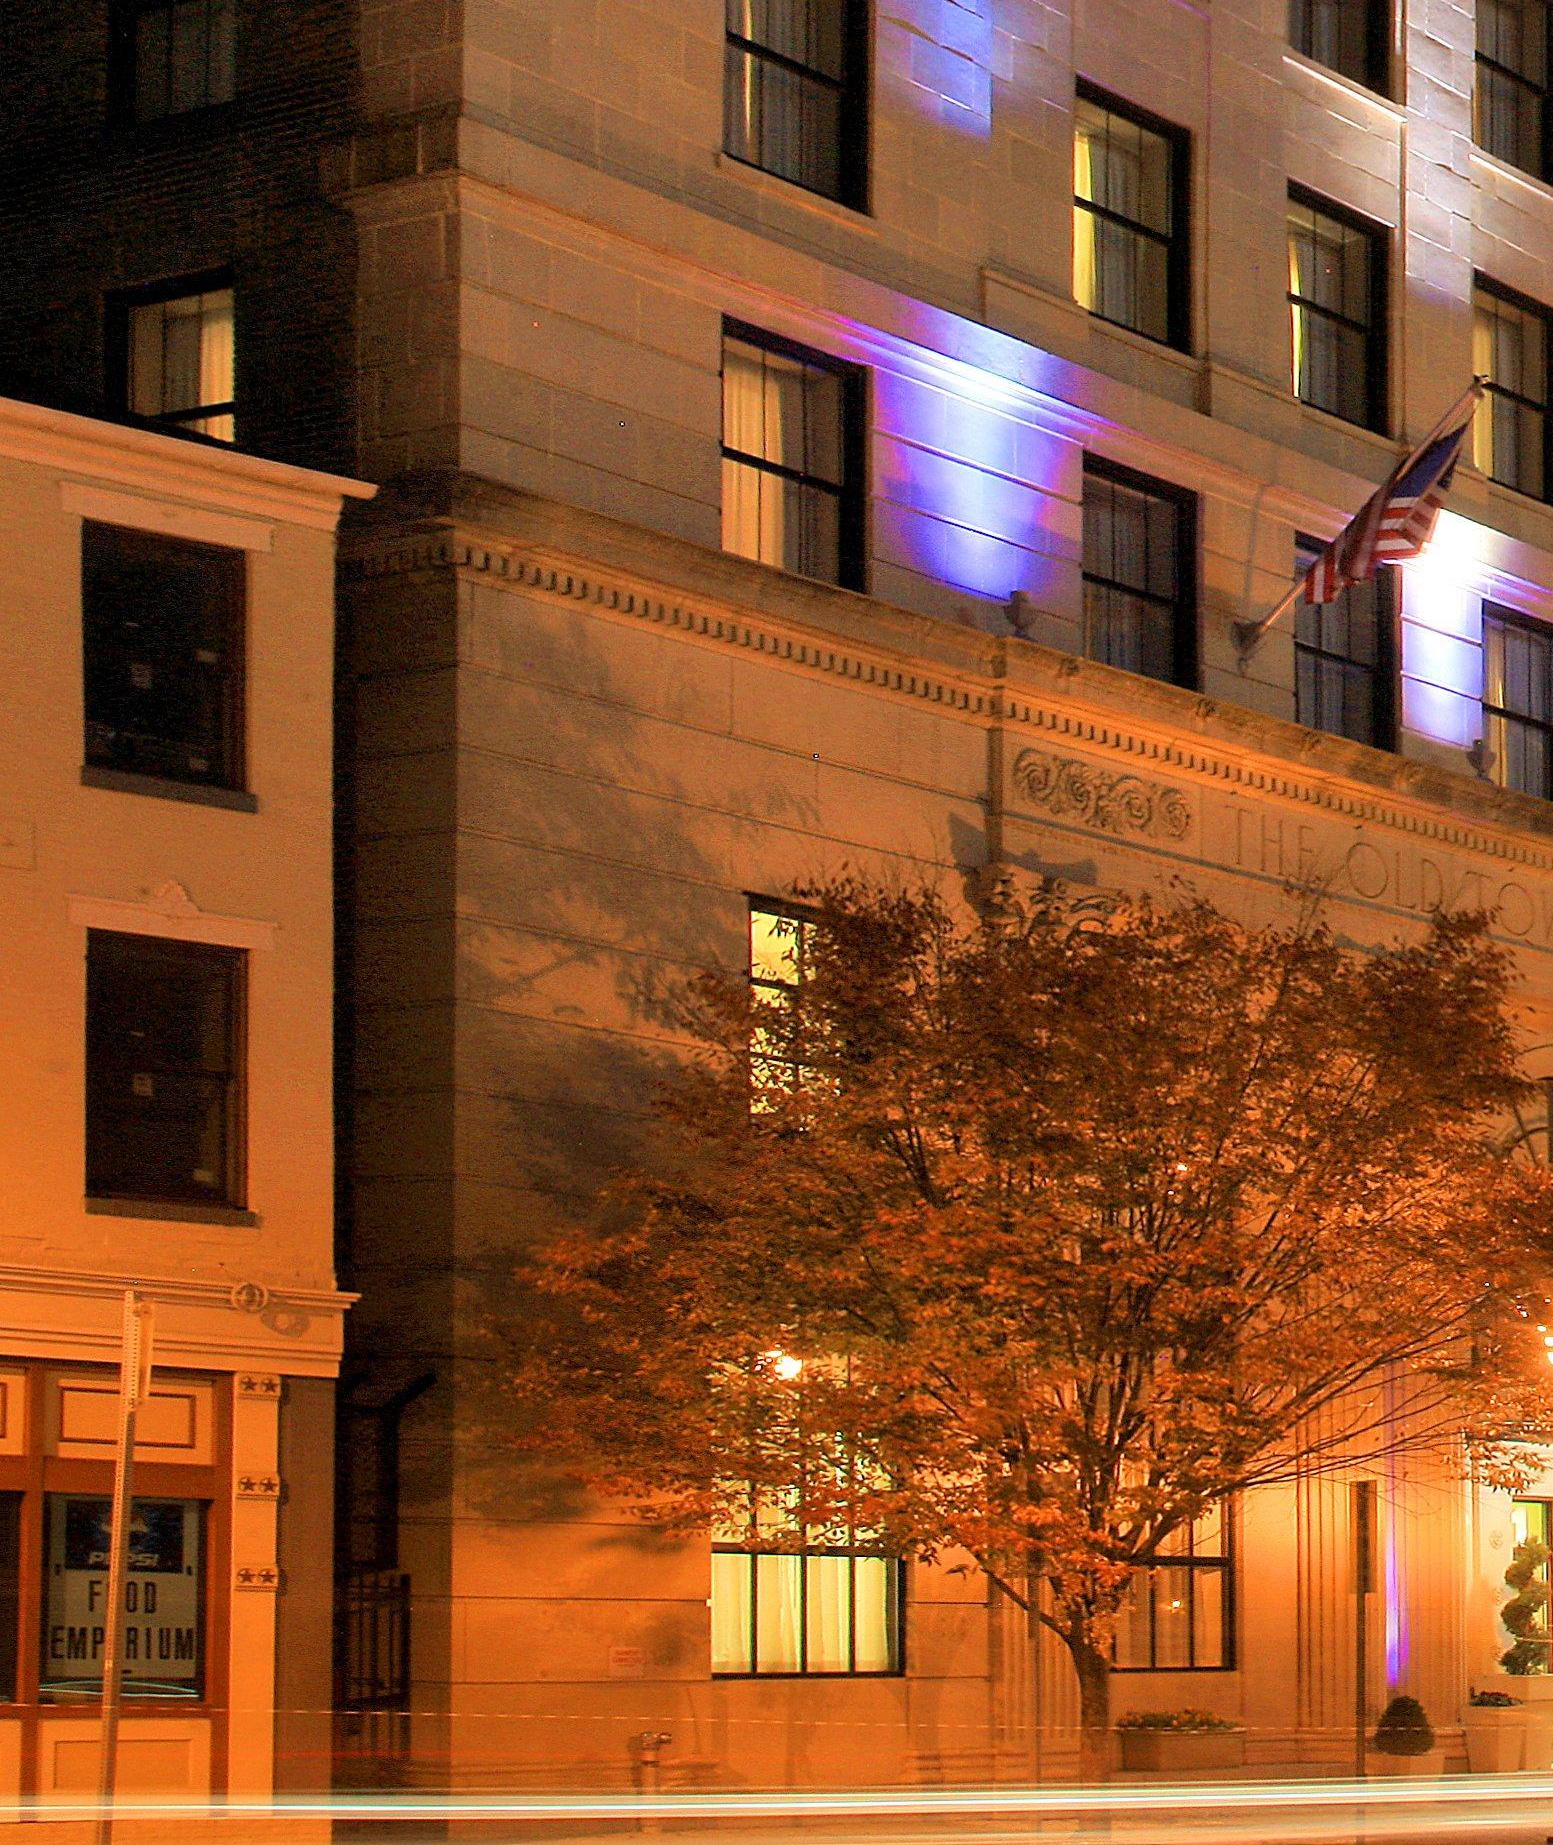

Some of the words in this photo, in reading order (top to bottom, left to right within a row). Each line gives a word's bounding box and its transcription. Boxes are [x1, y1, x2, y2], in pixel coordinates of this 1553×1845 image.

[1226, 805, 1315, 882] THE
[1346, 842, 1443, 913] OLD
[88, 1580, 157, 1614] FOD
[51, 1625, 194, 1660] EMPRIUM
